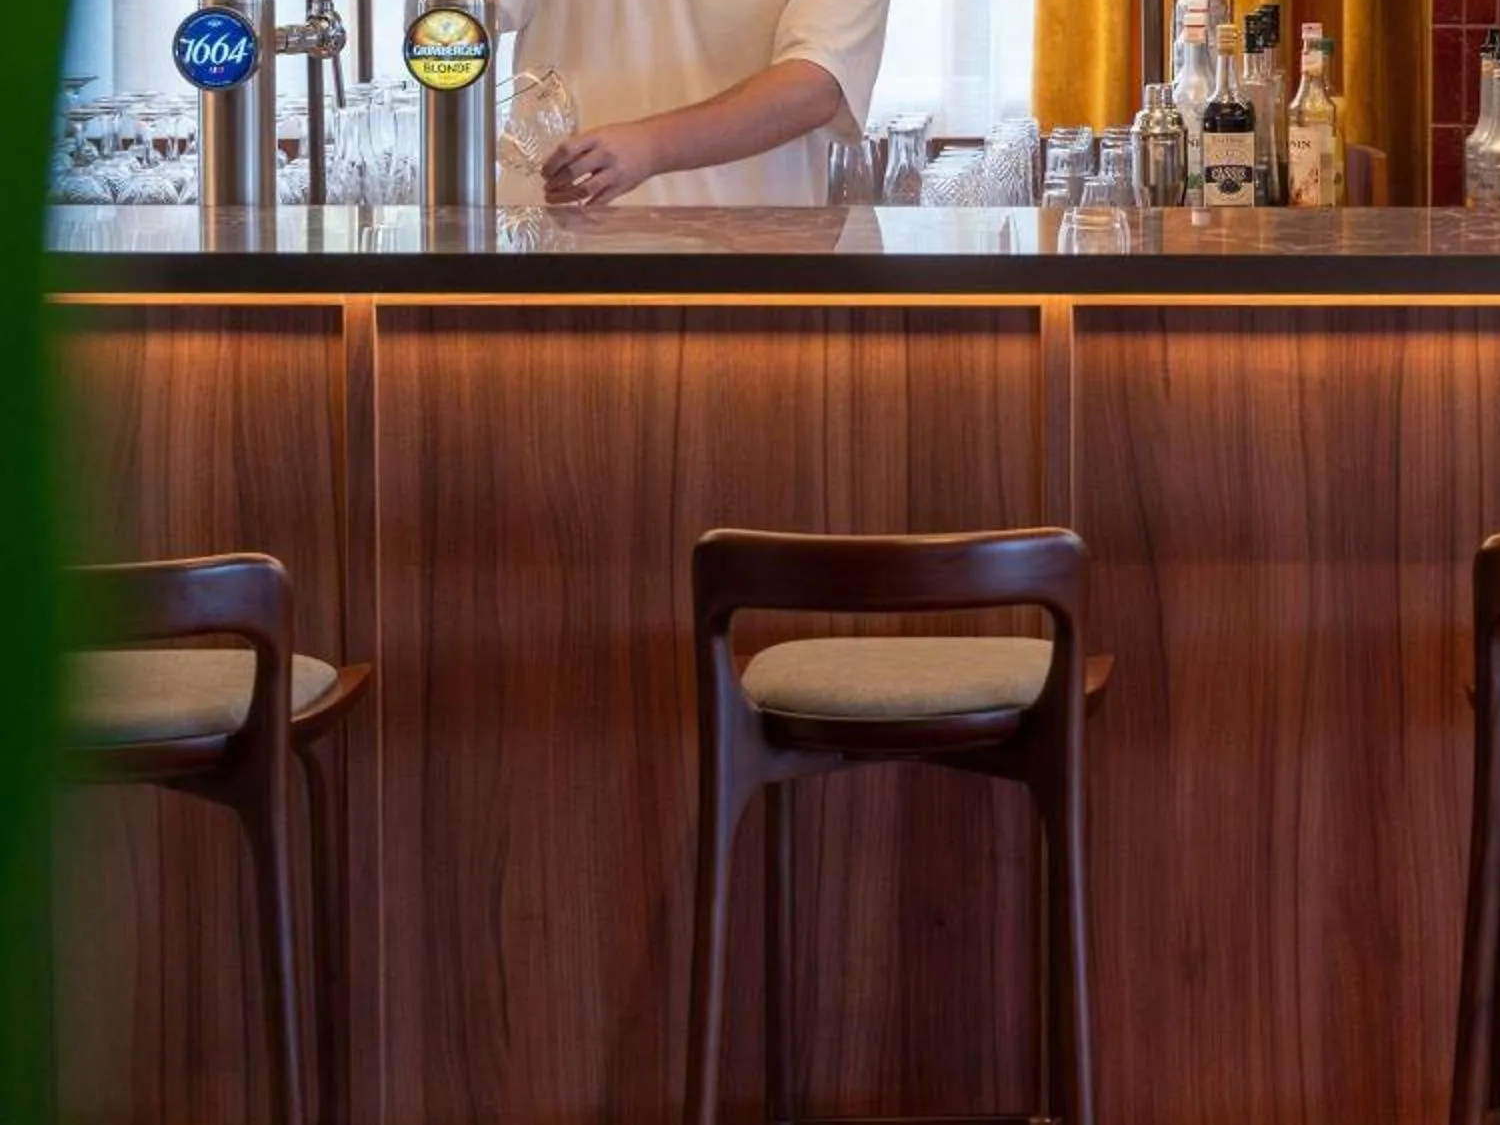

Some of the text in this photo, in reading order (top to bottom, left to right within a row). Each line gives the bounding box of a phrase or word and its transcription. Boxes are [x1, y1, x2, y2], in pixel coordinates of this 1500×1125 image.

[179, 32, 249, 65] 1664
[413, 43, 485, 56] GRIMBERGEN
[423, 62, 472, 74] BLONDE
